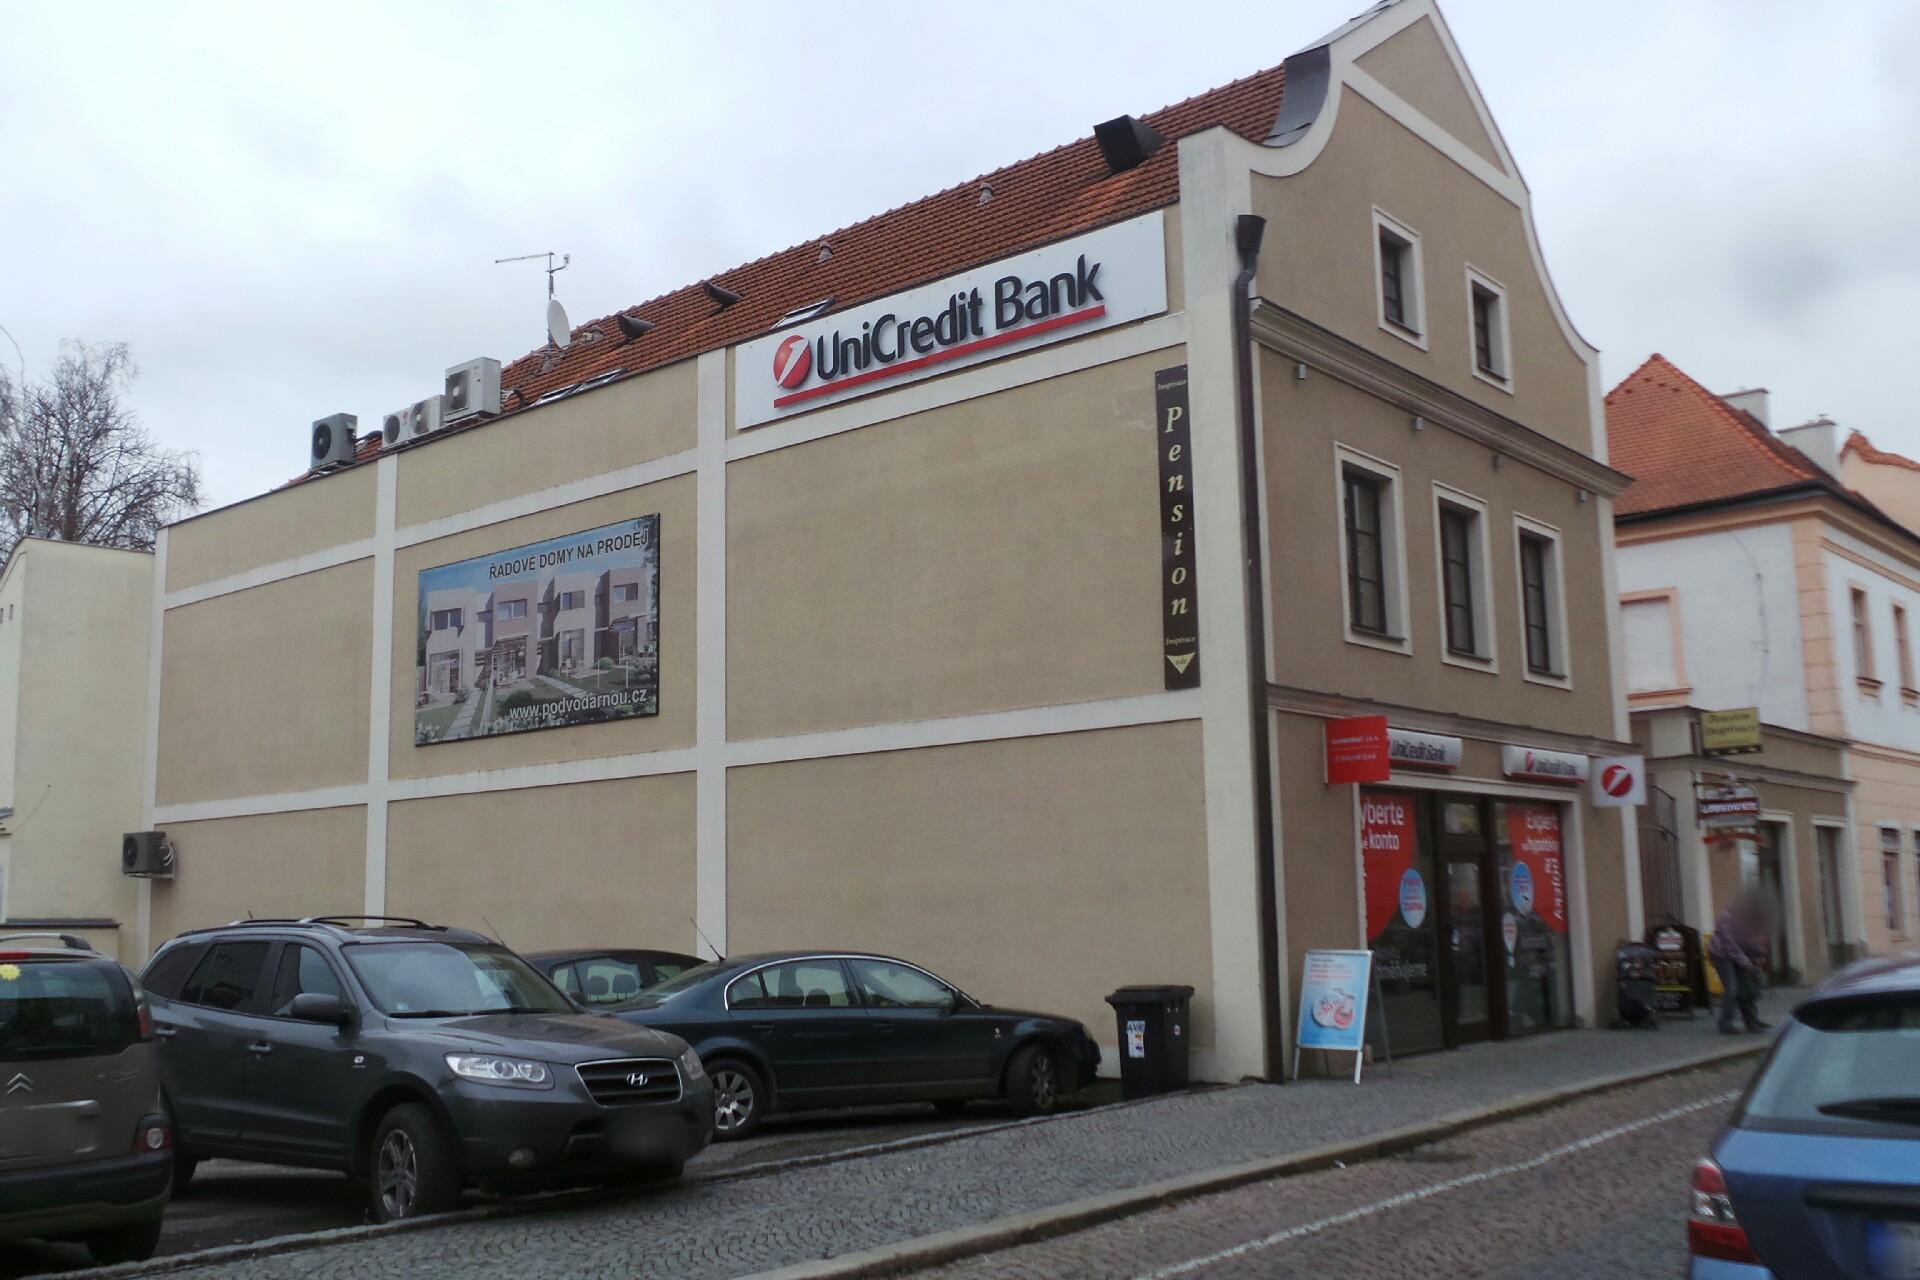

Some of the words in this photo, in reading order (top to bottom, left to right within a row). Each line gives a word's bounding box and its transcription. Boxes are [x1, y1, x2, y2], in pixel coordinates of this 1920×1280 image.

[816, 286, 983, 381] UniCredit
[995, 254, 1105, 331] Bank
[1164, 406, 1189, 616] Pension
[489, 553, 536, 580] ŘADOVÉ
[539, 547, 574, 568] DOMY
[577, 543, 594, 560] NA
[597, 530, 649, 556] PRODEJ
[509, 688, 648, 720] www.podvodarnou.cz
[1391, 738, 1425, 760] UniCredit
[1369, 828, 1400, 850] konto
